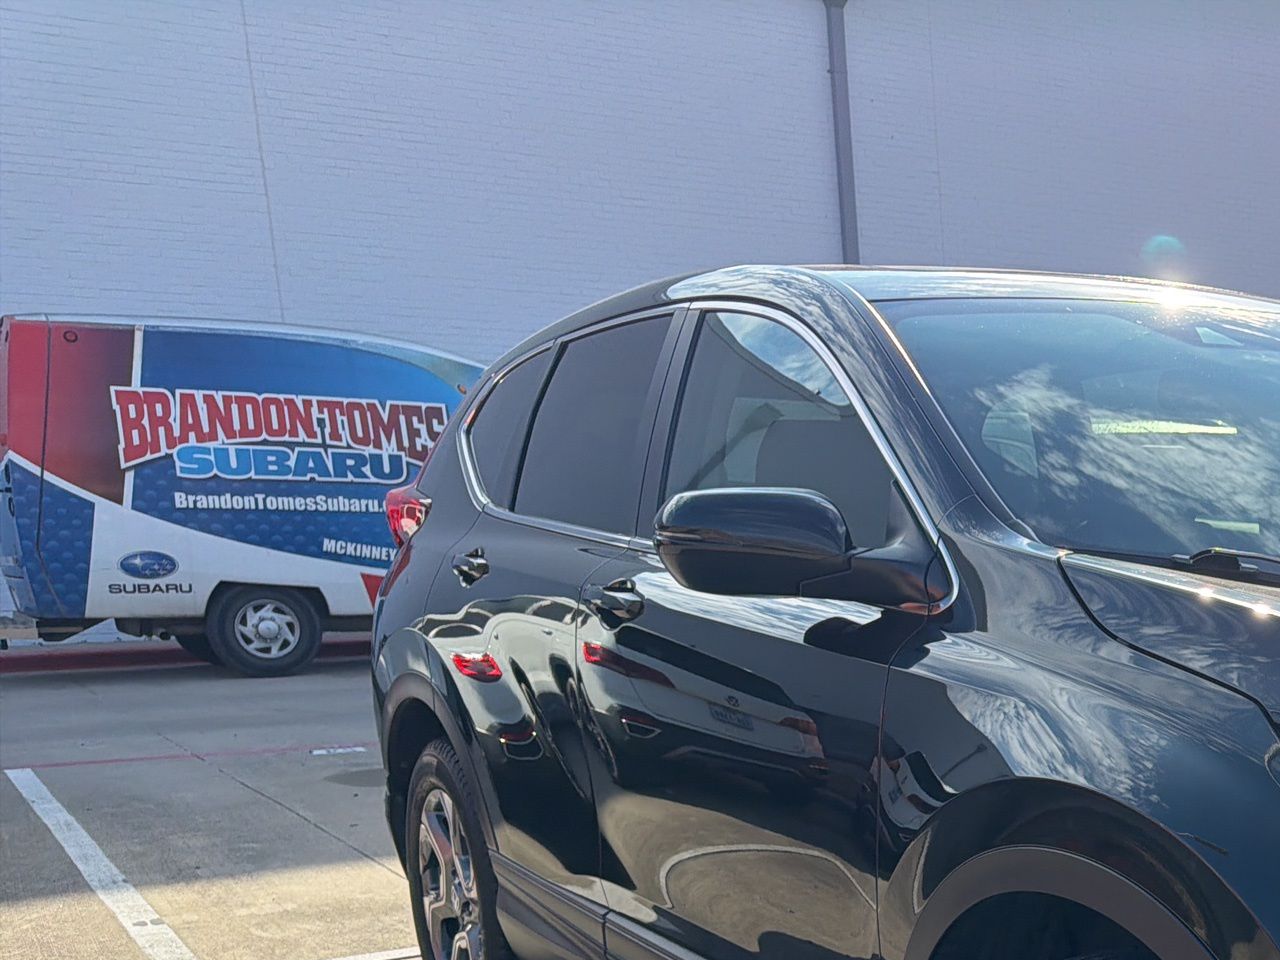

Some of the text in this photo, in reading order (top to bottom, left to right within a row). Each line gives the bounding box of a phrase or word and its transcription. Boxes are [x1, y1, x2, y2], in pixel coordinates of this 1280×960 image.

[112, 387, 318, 466] BRANDON
[175, 444, 405, 482] SUBARU
[174, 491, 387, 513] BrandonTomesSubaru.
[322, 537, 397, 561] MCKINNEY
[108, 583, 193, 594] SUBARU
